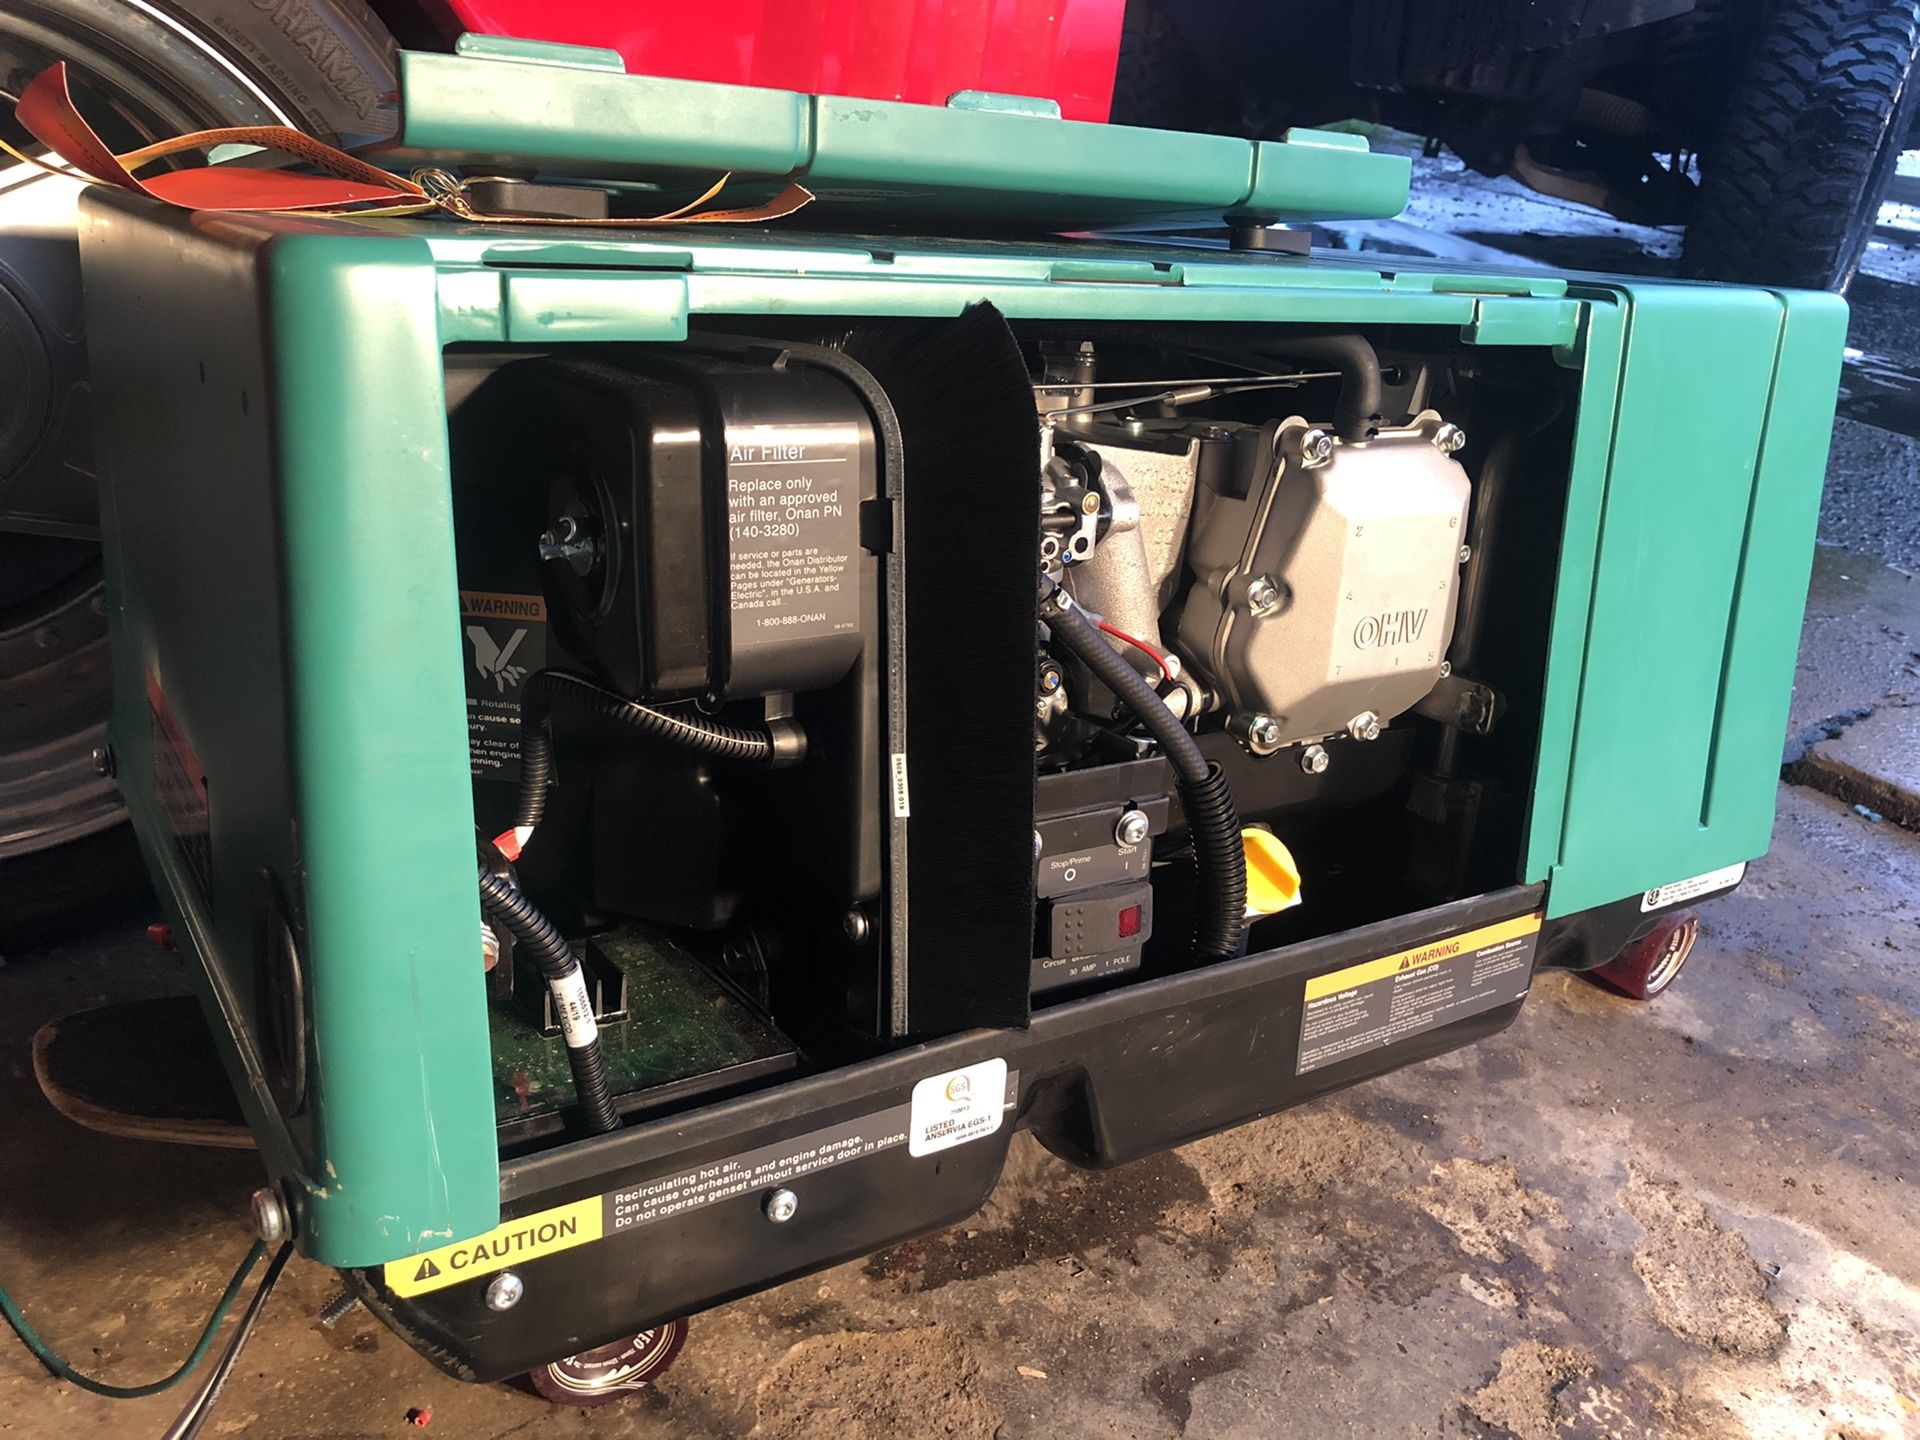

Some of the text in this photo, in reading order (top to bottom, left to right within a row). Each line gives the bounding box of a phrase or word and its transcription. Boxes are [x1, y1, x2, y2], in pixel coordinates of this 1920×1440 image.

[730, 444, 805, 461] Air Filter
[729, 476, 813, 493] Replace only
[728, 489, 838, 507] with an approved
[729, 504, 842, 523] air filter, Onan PN
[729, 523, 800, 541] (140-3280)
[1355, 526, 1363, 537] 2
[730, 552, 736, 560] If
[738, 551, 769, 560] service
[770, 550, 780, 558] or
[781, 549, 803, 559] parts
[782, 558, 805, 567] Onan
[807, 555, 848, 565] Distributor
[748, 571, 759, 579] be
[761, 568, 792, 578] located
[794, 566, 801, 575] in
[803, 566, 816, 574] the
[818, 564, 844, 573] Yellow
[730, 581, 758, 591] Pages
[759, 579, 784, 588] under
[770, 588, 778, 596] in
[780, 588, 793, 596] the
[824, 583, 840, 592] and
[471, 599, 540, 617] WARNING
[730, 600, 764, 609] Canada
[756, 613, 826, 627] 1-800-888-ONAN
[1353, 608, 1428, 650] OHV
[481, 699, 522, 712] Rotating
[478, 714, 507, 723] cause
[469, 724, 488, 732] ury.
[483, 739, 507, 748] clear
[1118, 846, 1137, 856] Start
[1050, 855, 1092, 870] Stop/Prime
[1411, 942, 1460, 966] WARNING
[1081, 963, 1097, 973] AMP
[1113, 954, 1131, 965] POLE
[559, 1004, 573, 1034] MEXICO
[925, 1119, 955, 1134] LISTED
[615, 1135, 863, 1216] Can cause overheating and engine damage.
[615, 1132, 907, 1228] Do not operate genset without service door in place.
[615, 1162, 741, 1205] Recirculating hot air.
[449, 1216, 577, 1270] CAUTION
